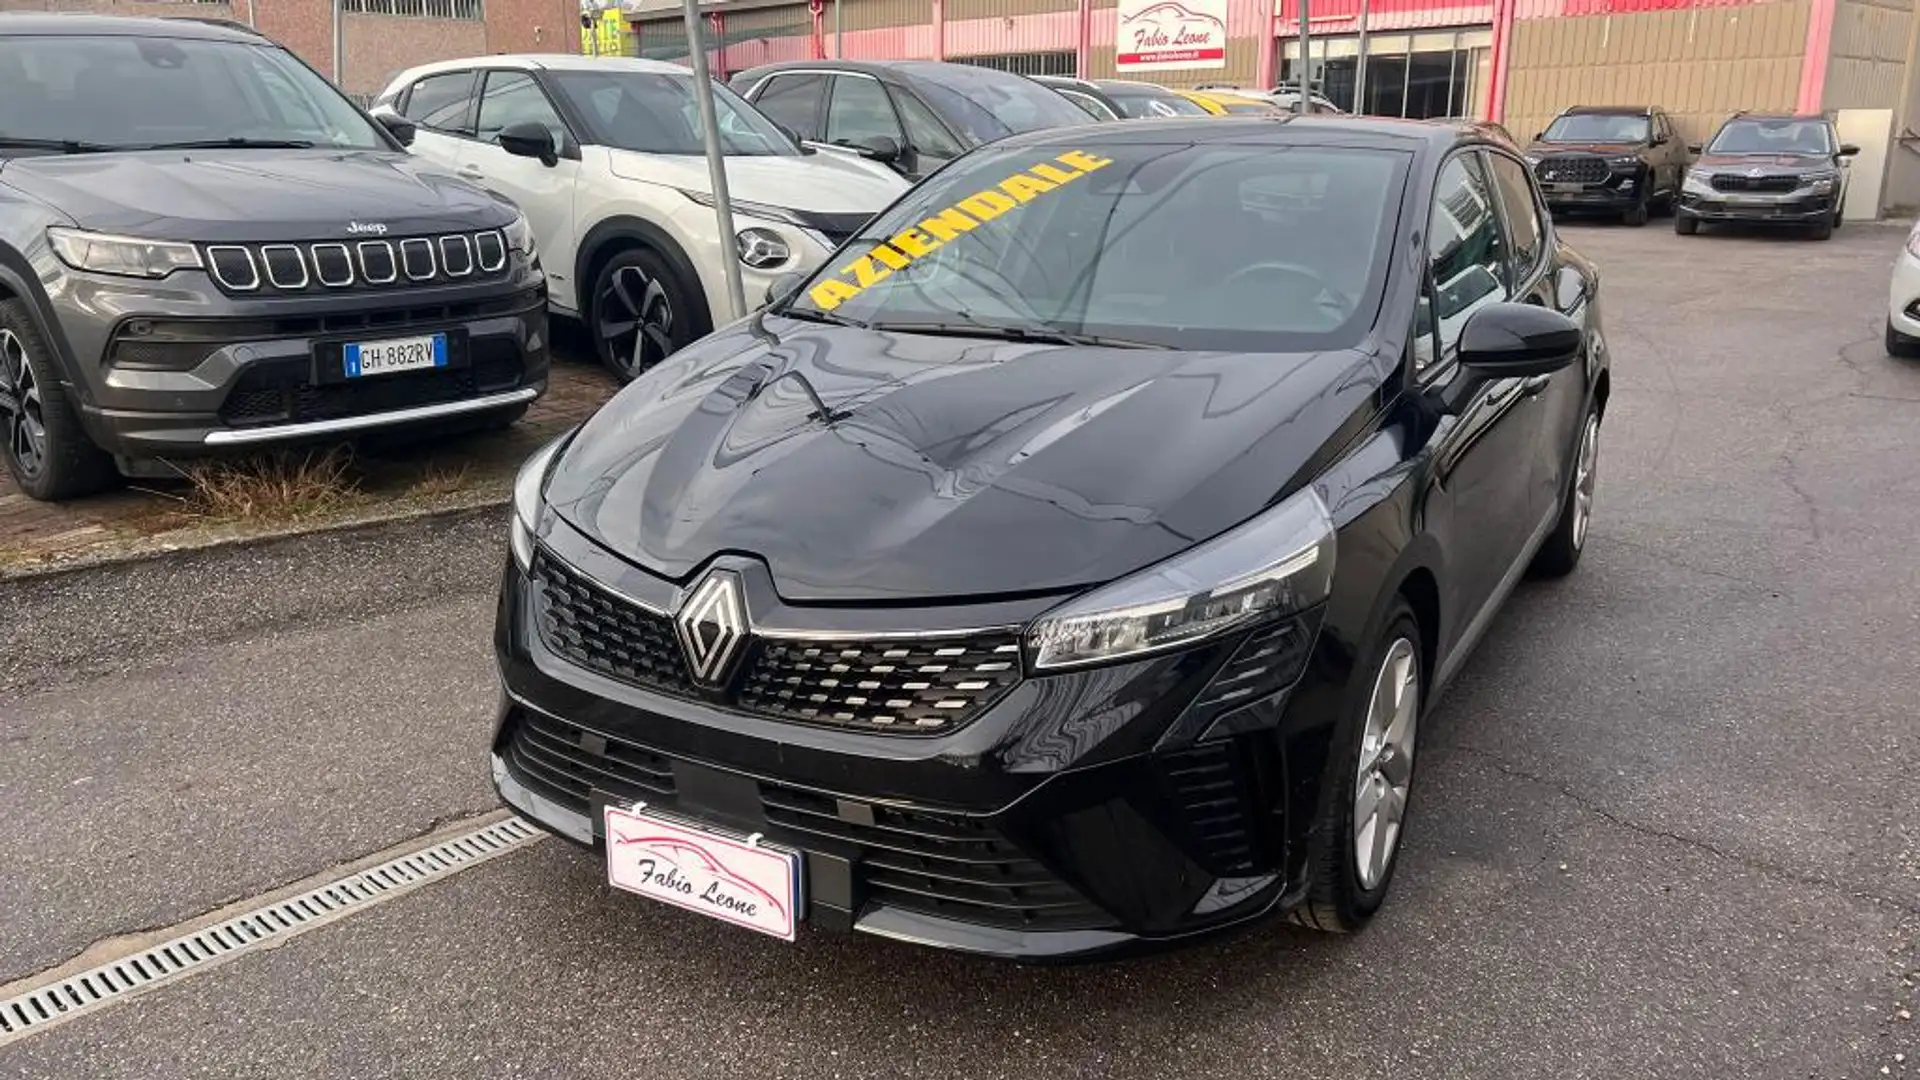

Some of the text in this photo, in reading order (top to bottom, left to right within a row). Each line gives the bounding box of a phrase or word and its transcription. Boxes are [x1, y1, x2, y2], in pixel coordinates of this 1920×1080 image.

[1134, 25, 1210, 52] Fabio Leone
[347, 221, 388, 235] Jeep
[809, 150, 1114, 311] AZIENDALE
[361, 342, 433, 369] GH 882RV
[638, 858, 758, 917] Fabio Leone
